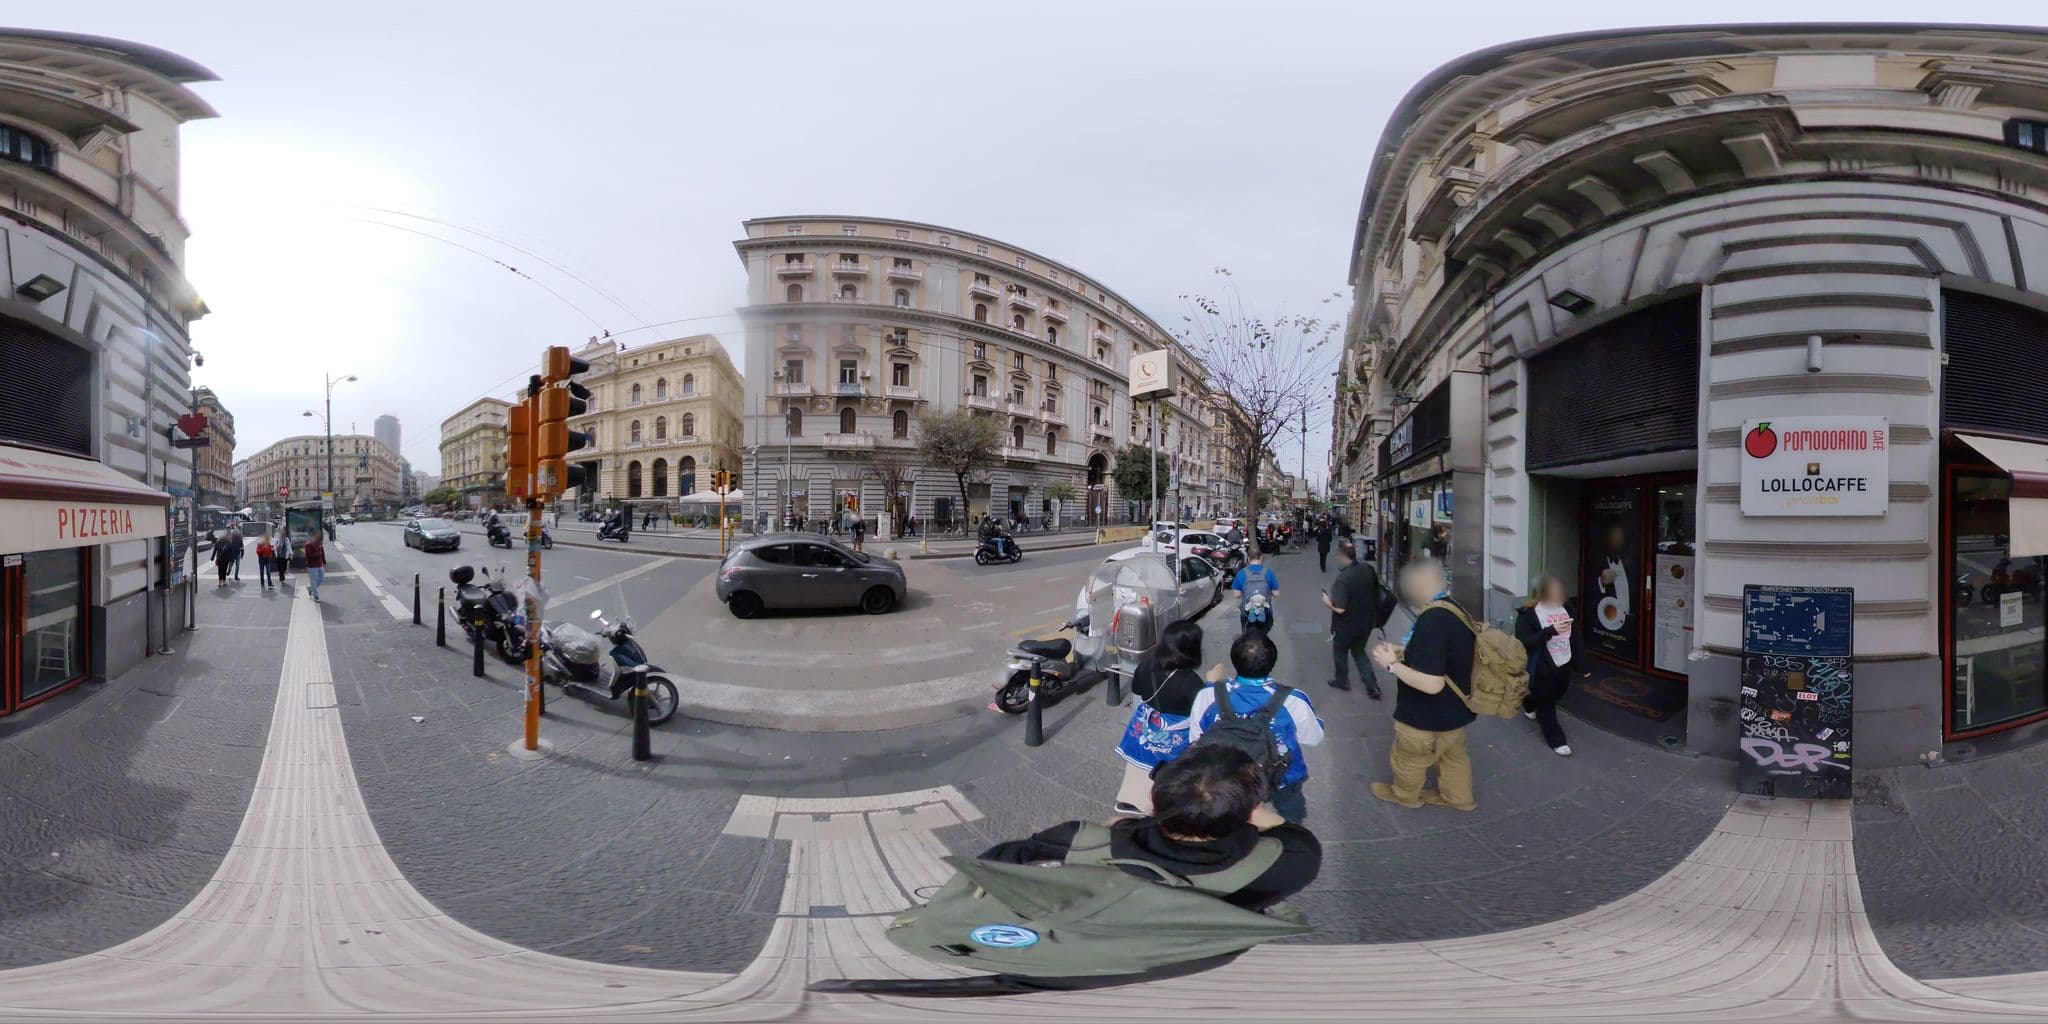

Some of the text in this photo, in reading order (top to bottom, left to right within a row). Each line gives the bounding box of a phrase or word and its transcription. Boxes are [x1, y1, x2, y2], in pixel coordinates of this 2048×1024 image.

[1783, 429, 1868, 451] POMODORINO
[1872, 430, 1884, 451] CAFE
[57, 508, 133, 539] PIZZERIA
